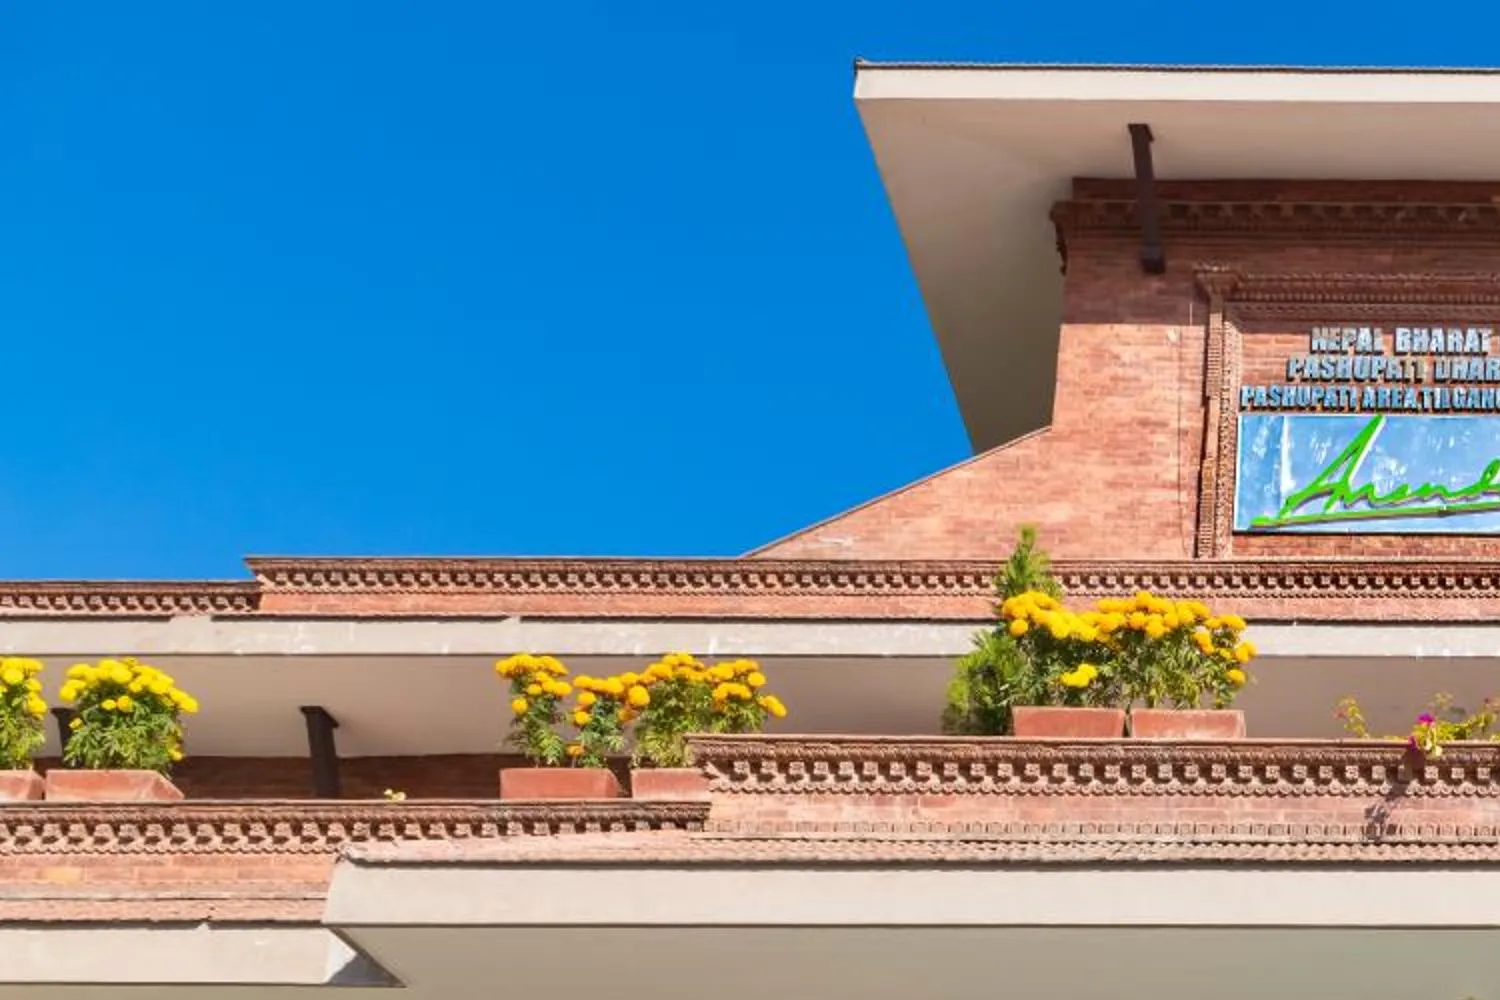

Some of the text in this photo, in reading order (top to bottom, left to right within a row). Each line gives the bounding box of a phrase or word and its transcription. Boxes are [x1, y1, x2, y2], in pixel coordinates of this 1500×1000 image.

[1311, 327, 1384, 353] NEPAL
[1394, 327, 1493, 354] BHARAT
[1287, 355, 1428, 381] PASHUPATI
[1241, 384, 1358, 409] PASHUPATI
